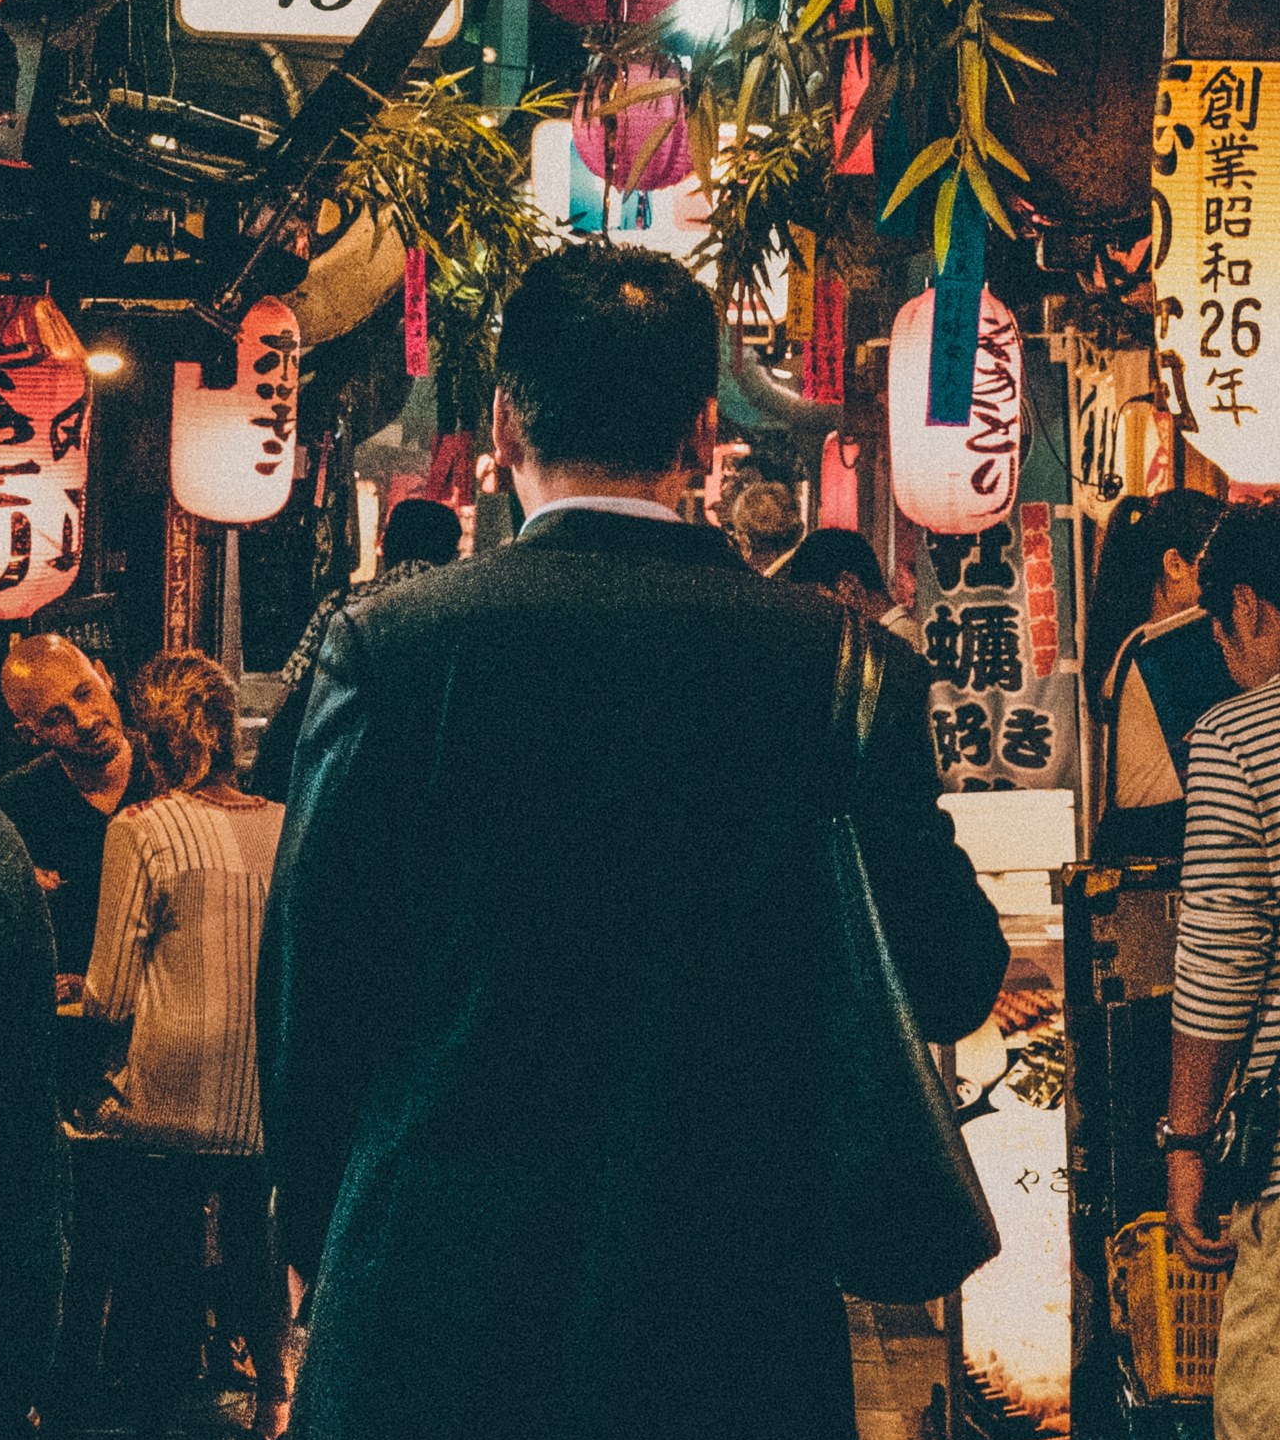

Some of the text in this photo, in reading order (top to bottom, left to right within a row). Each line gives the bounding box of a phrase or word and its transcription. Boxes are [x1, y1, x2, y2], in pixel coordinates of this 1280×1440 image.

[1198, 65, 1264, 428] 創業昭和26年
